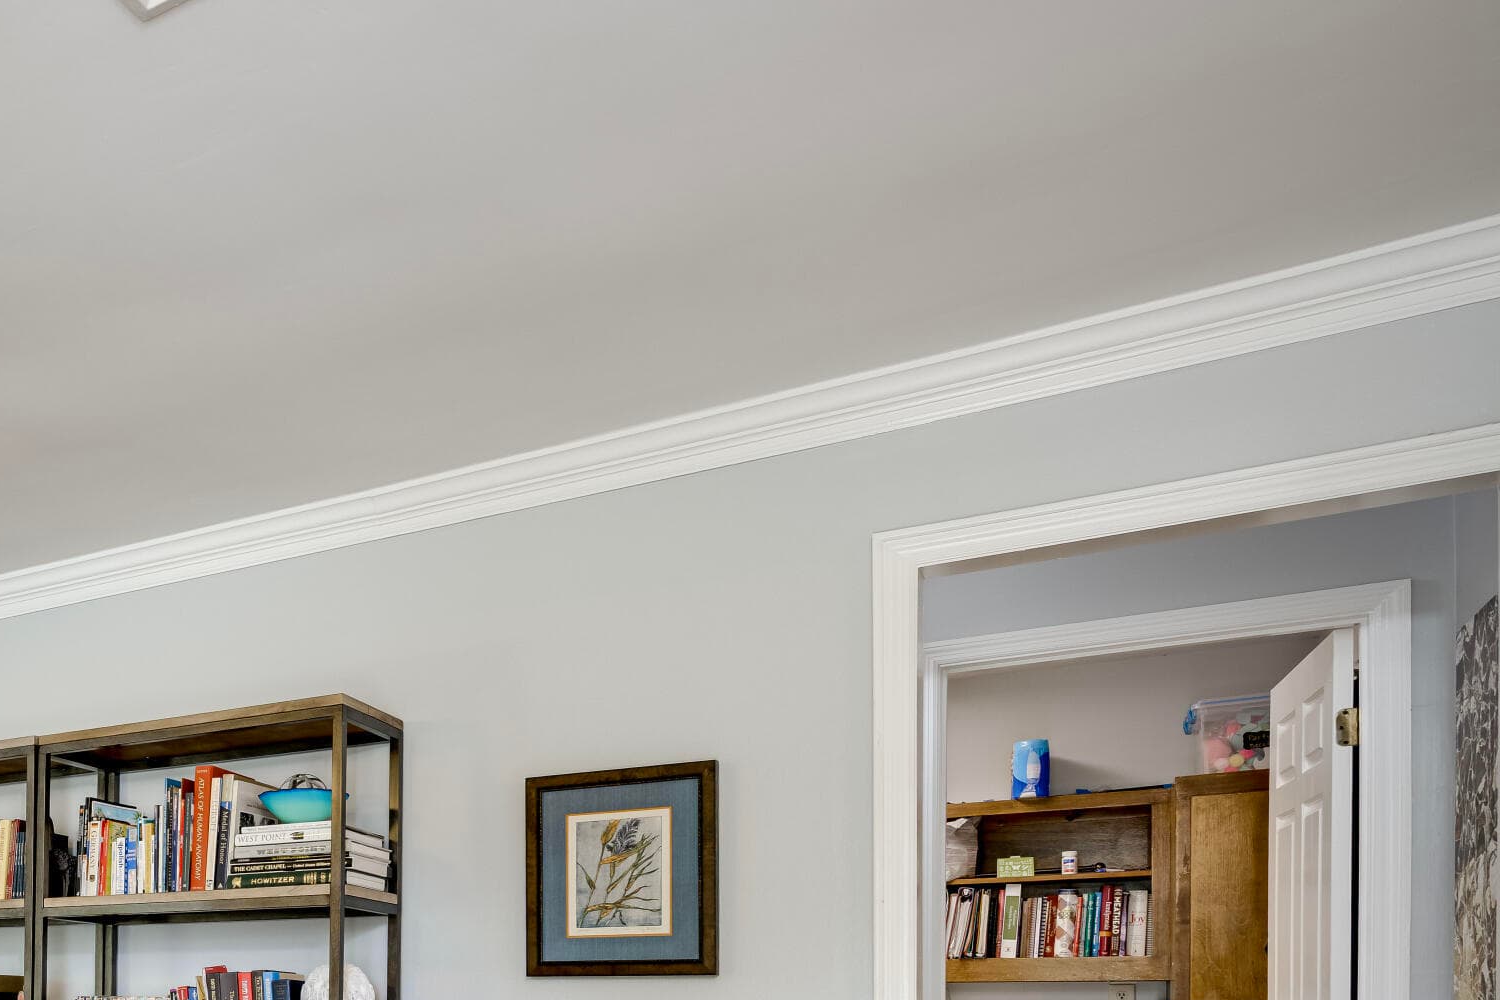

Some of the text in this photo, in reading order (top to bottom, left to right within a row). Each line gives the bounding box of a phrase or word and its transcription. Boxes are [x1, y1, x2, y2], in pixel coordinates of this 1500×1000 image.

[194, 777, 205, 881] ATLAS OF HUMAN ANATOMY
[219, 810, 229, 865] Medal of Honor
[238, 832, 286, 843] WEST POINT
[250, 876, 295, 885] HOWITZER
[1112, 896, 1121, 934] MEATHEAD
